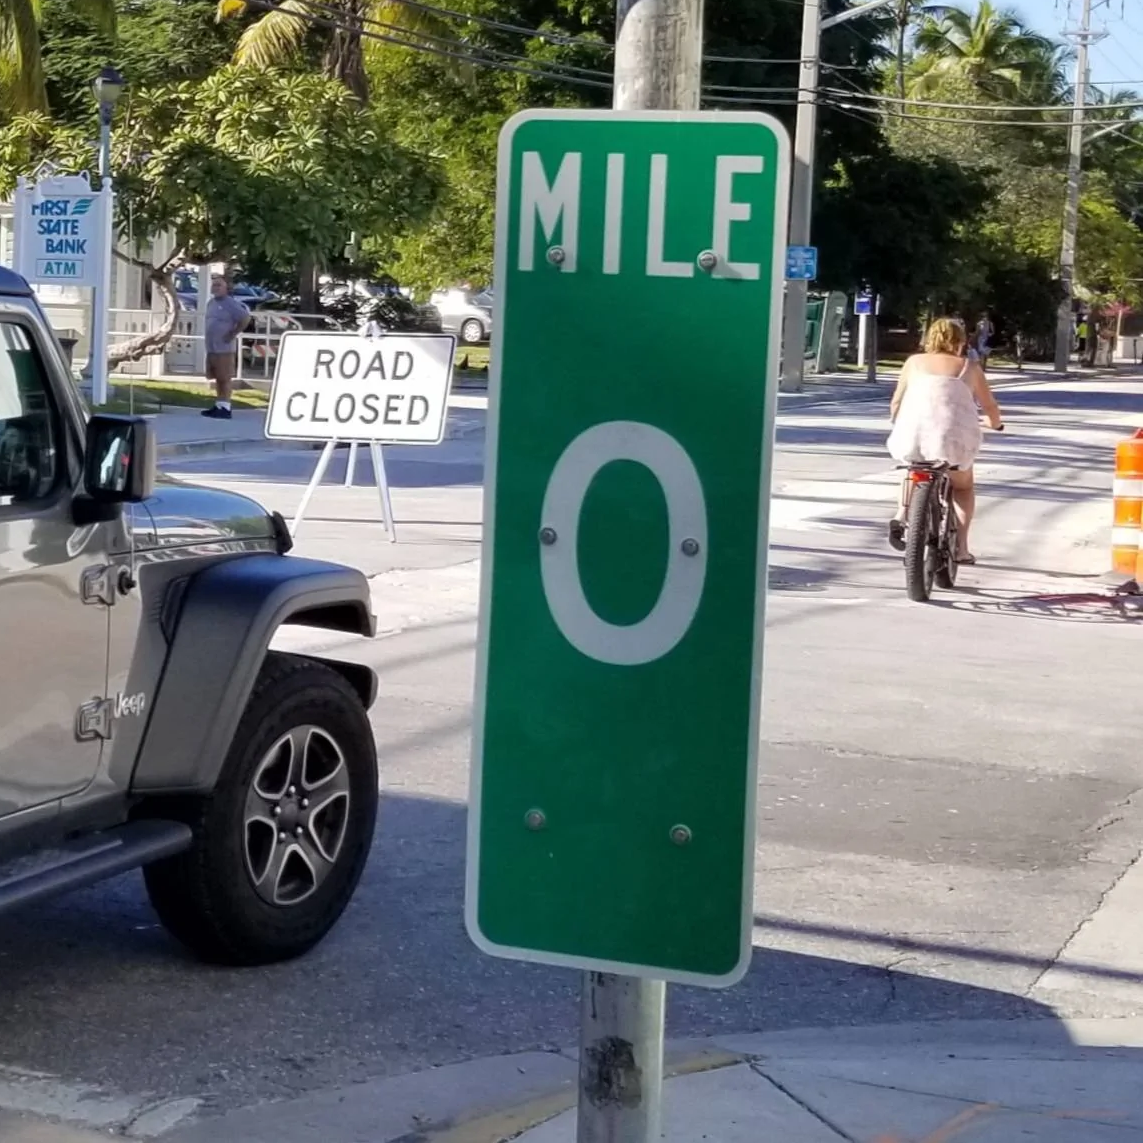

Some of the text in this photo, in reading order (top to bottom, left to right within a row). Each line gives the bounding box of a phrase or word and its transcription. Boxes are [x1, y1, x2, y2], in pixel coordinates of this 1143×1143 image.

[31, 199, 70, 216] FIRST
[518, 150, 764, 280] MILE
[37, 219, 79, 235] STATE
[45, 239, 87, 255] BANK
[44, 261, 76, 275] ATM
[313, 349, 414, 381] ROAD
[286, 391, 430, 426] CLOSED
[539, 420, 708, 665] 0
[114, 691, 145, 718] Jeep
